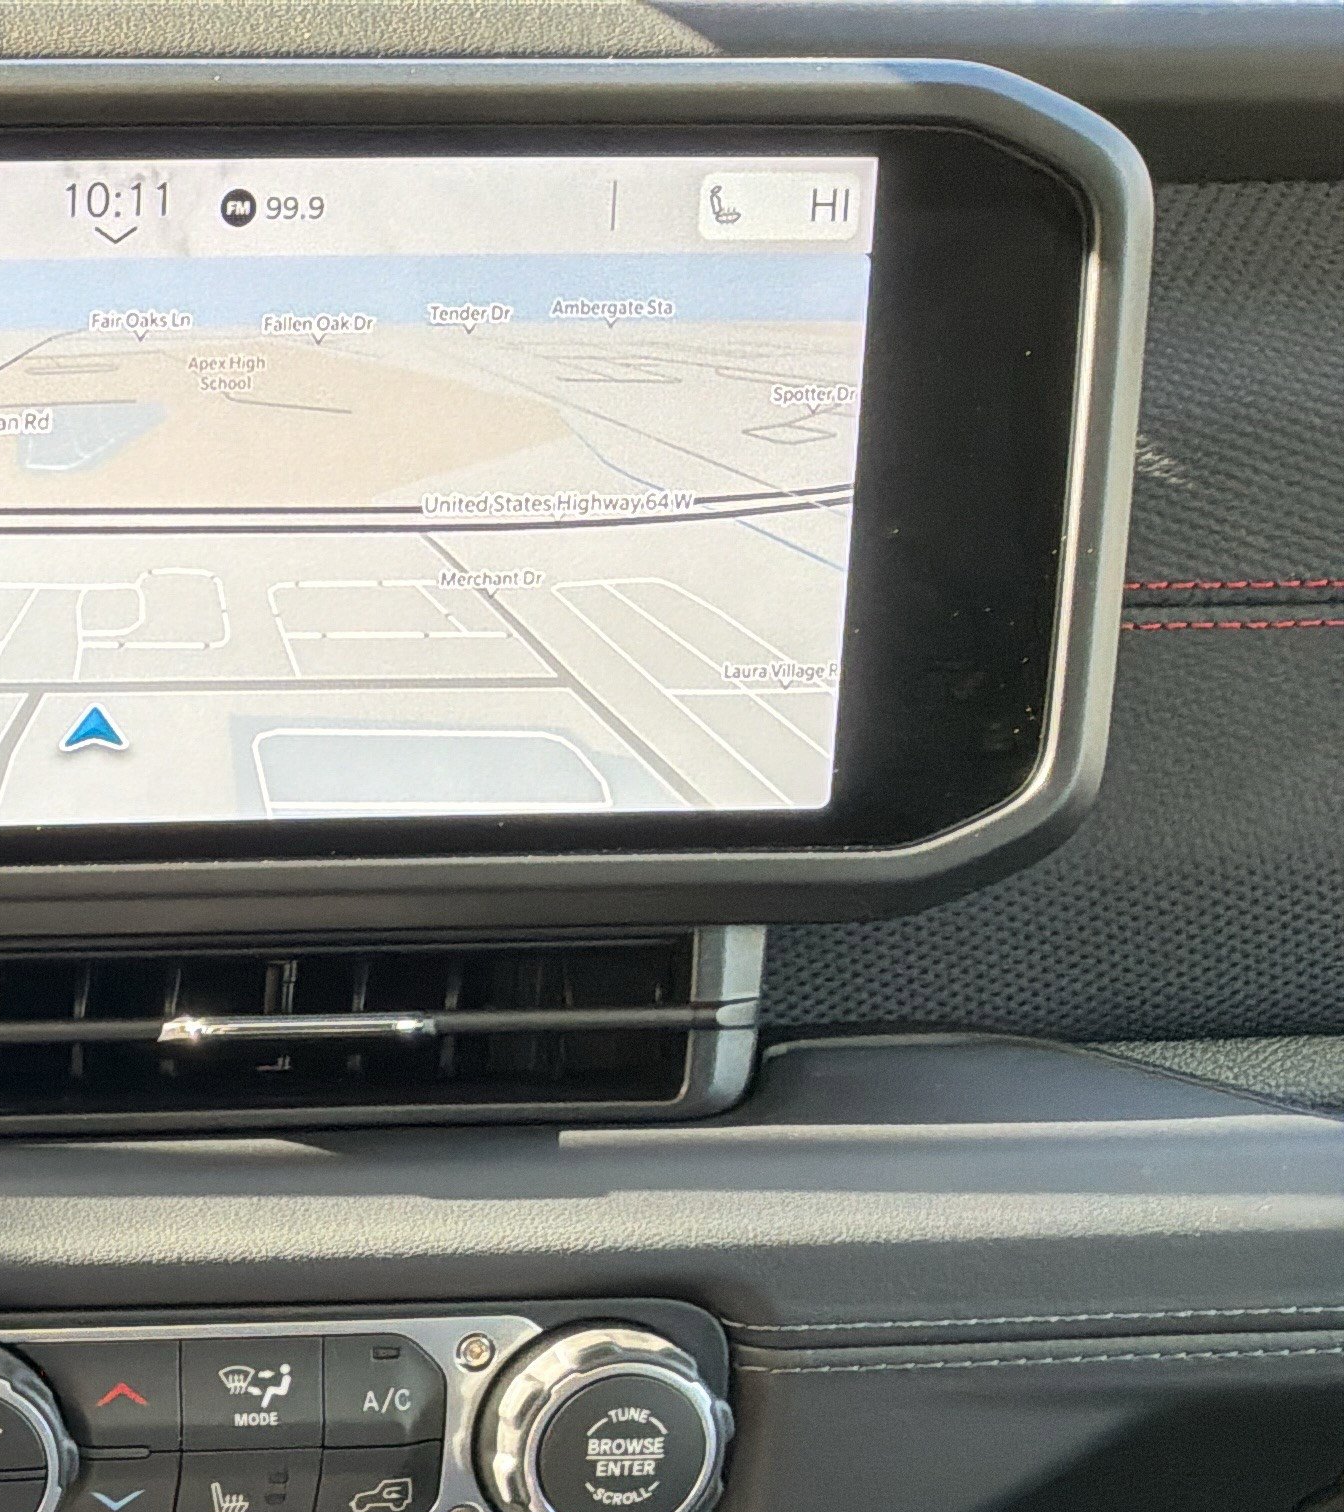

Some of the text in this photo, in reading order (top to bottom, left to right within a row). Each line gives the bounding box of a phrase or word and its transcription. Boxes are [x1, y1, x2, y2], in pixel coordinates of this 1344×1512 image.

[66, 181, 170, 219] 10:11
[227, 197, 325, 220] FM 99.9
[811, 188, 851, 222] HI
[430, 307, 511, 321] Tender Dr
[552, 301, 673, 319] Ambergate Sta
[92, 313, 191, 329] Fair Oaks Ln
[264, 316, 374, 331] Fallen Oak Dr
[188, 354, 265, 373] Apex High
[200, 375, 251, 391] School
[774, 386, 855, 404] Spotter Dr
[23, 413, 50, 432] Rd
[424, 494, 692, 515] United States Highway 64 W
[441, 572, 542, 587] Merchant Dr
[724, 664, 767, 679] Laura
[771, 663, 826, 683] Village
[362, 1388, 411, 1413] A/C
[234, 1411, 280, 1427] MODE
[607, 1407, 650, 1426] TUNE
[586, 1436, 664, 1455] BROWSE
[595, 1459, 656, 1477] ENTER
[593, 1486, 651, 1505] SCROLL
